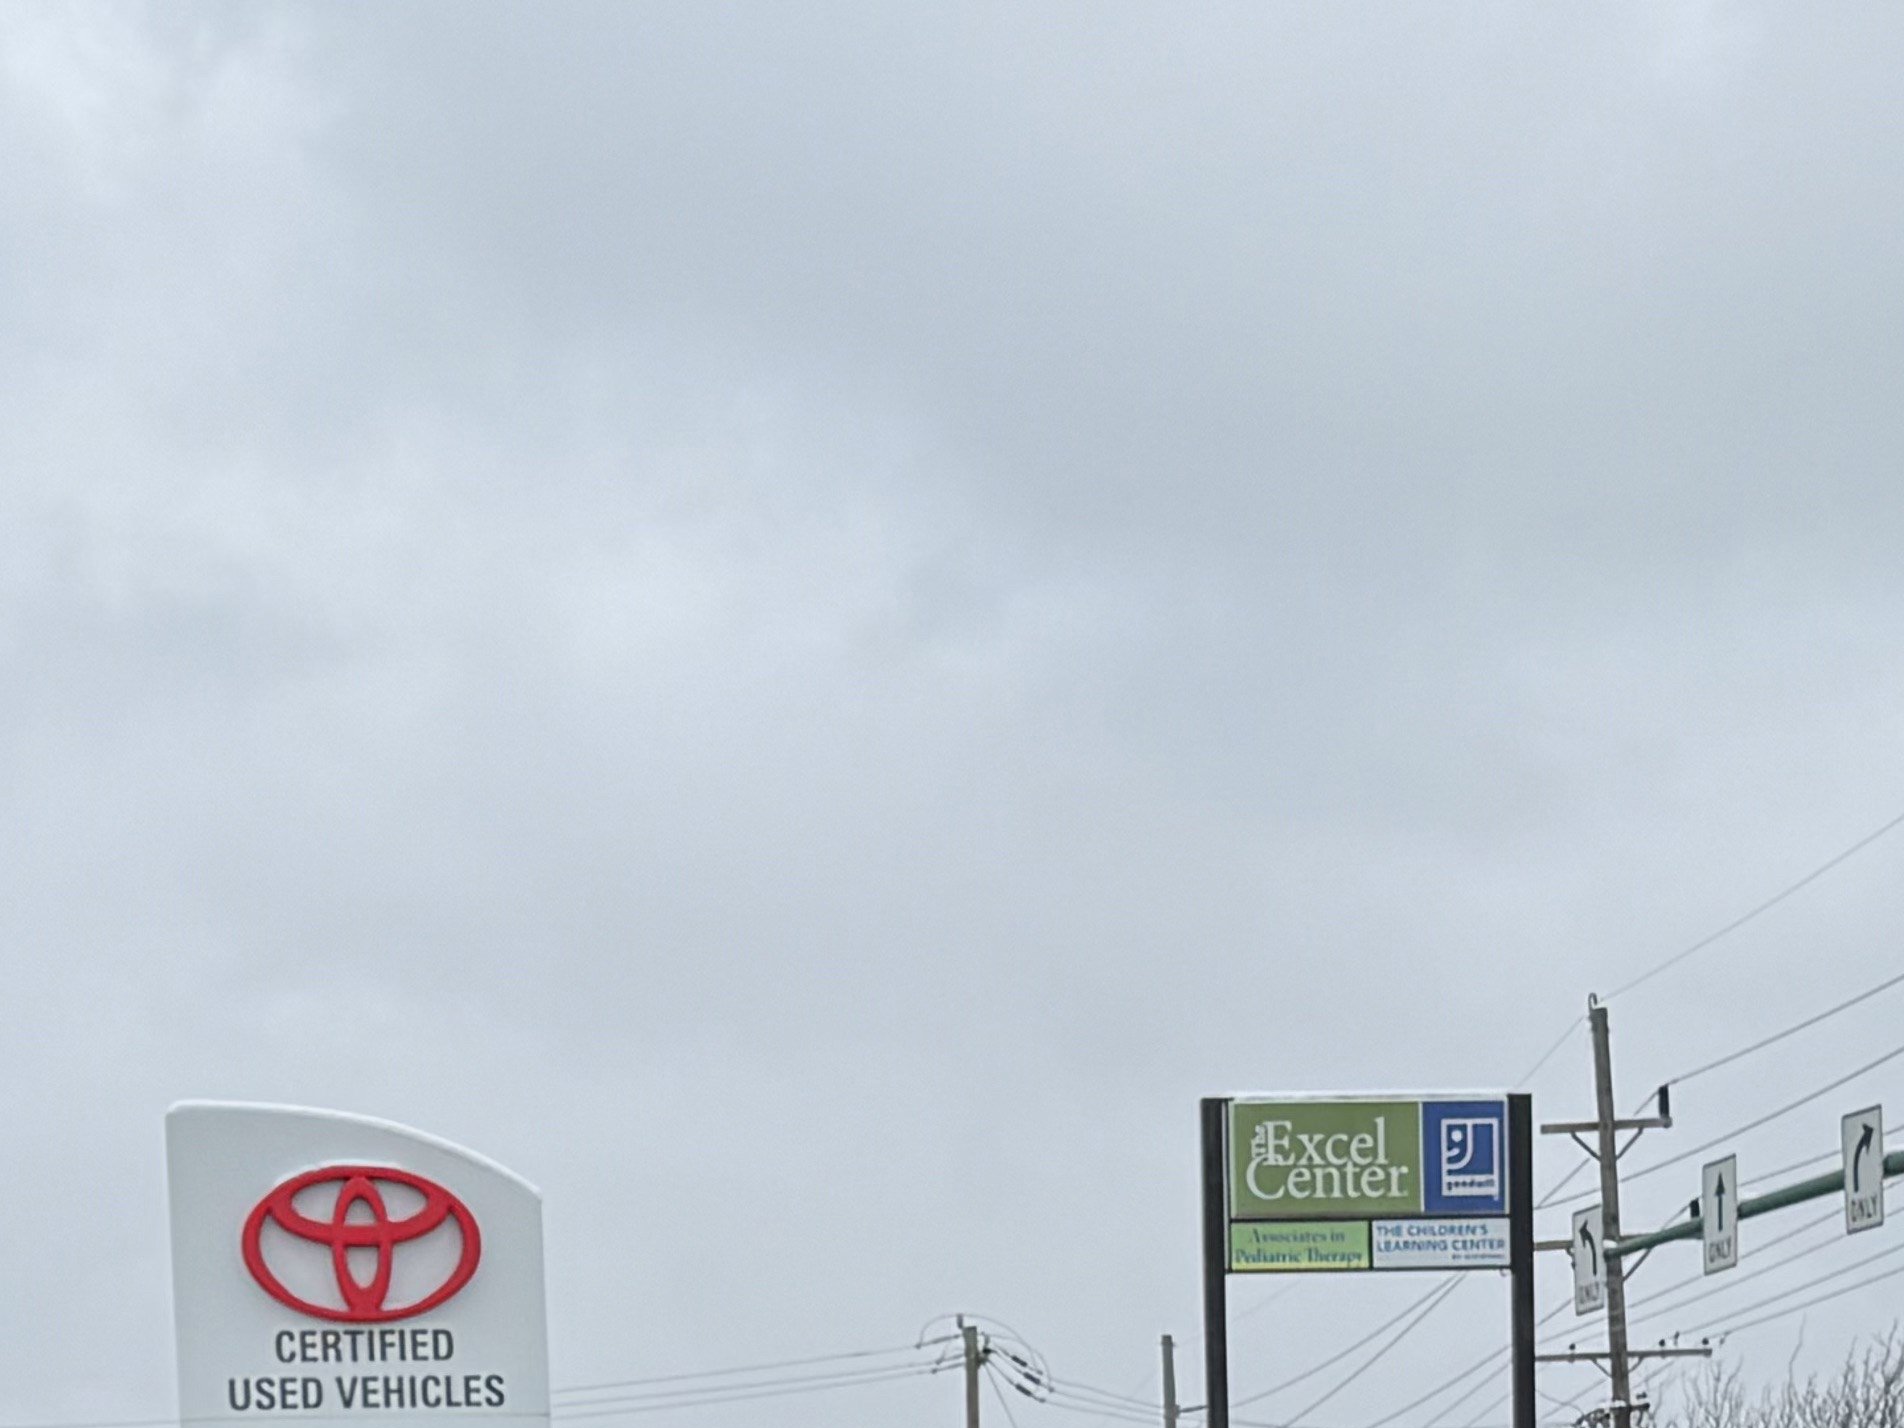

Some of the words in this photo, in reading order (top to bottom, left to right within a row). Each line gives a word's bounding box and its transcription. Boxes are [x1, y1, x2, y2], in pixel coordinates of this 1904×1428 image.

[1262, 1117, 1388, 1166] Excel
[1246, 1153, 1410, 1200] Center
[1377, 1225, 1402, 1236] THE
[1377, 1240, 1448, 1252] LEARNING
[1452, 1238, 1505, 1251] CENTER
[1307, 1246, 1363, 1268] Therapy
[275, 1329, 454, 1363] CERTIFIED
[228, 1377, 323, 1411] USED
[335, 1375, 505, 1408] VEHICLES
